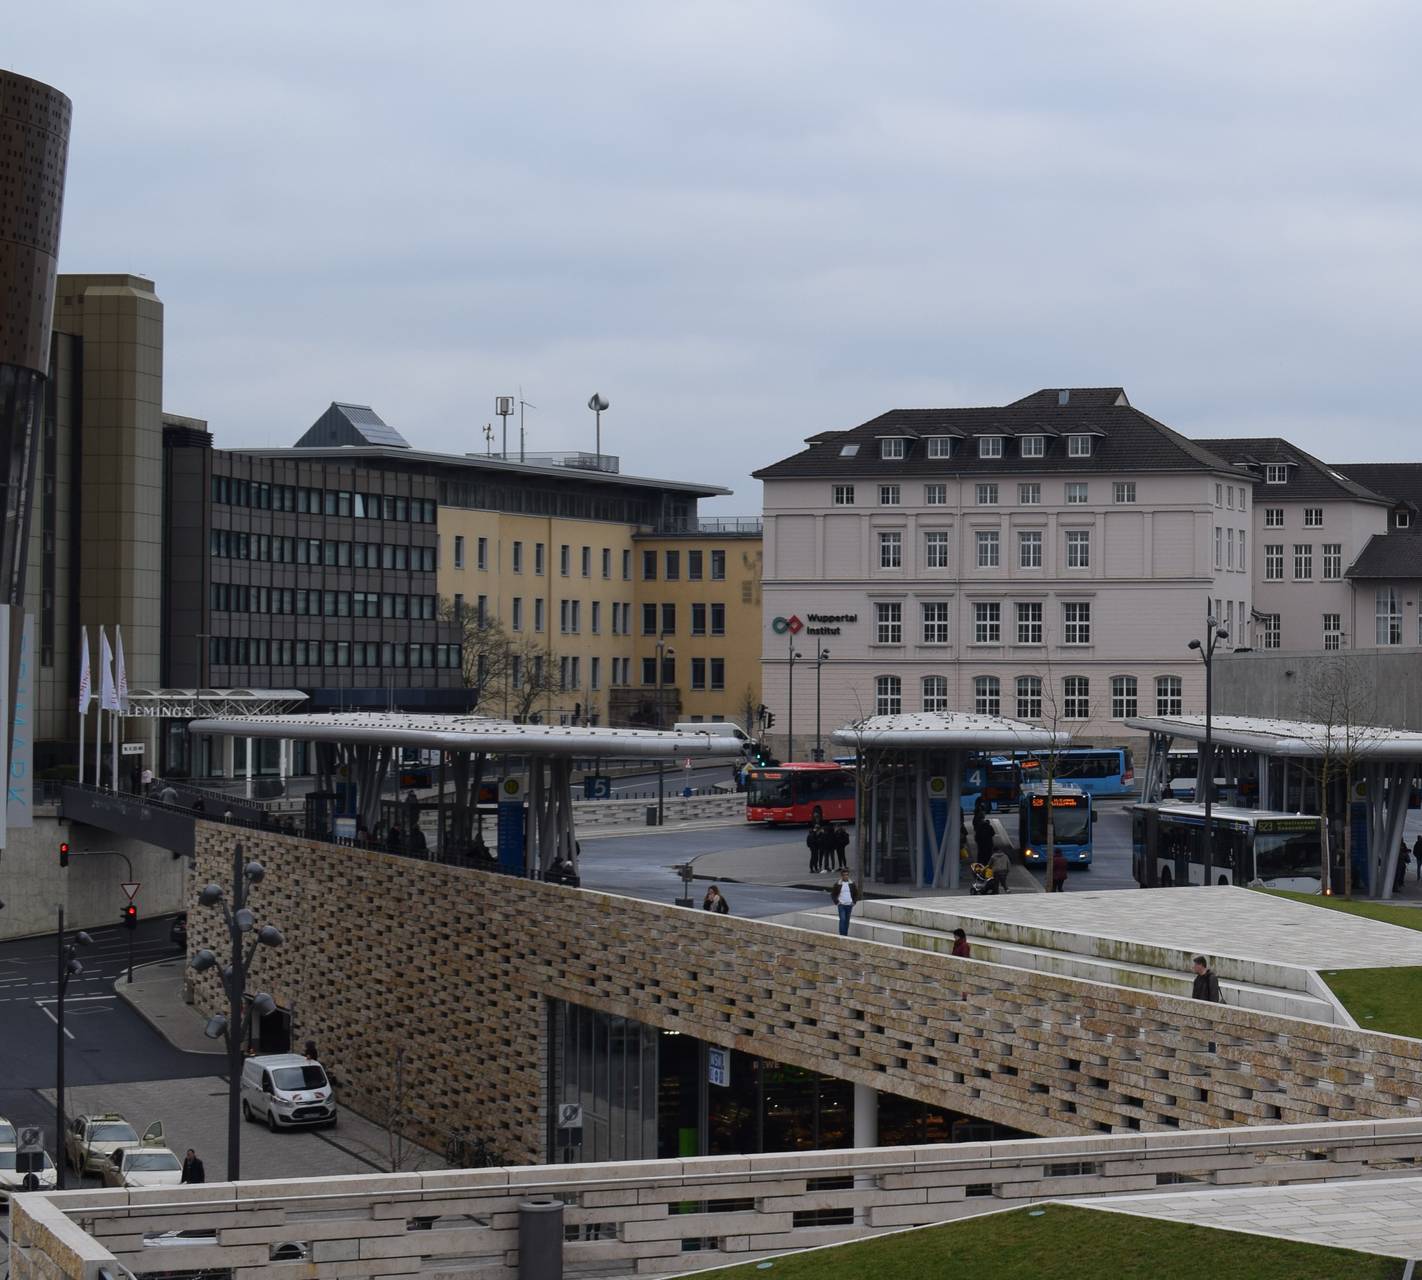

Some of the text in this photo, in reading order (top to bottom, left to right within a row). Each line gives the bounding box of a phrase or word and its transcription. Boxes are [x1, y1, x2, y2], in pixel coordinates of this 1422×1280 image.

[806, 613, 858, 623] Wuppertal
[806, 626, 841, 636] Institut
[969, 770, 981, 787] 4
[594, 779, 607, 797] 5
